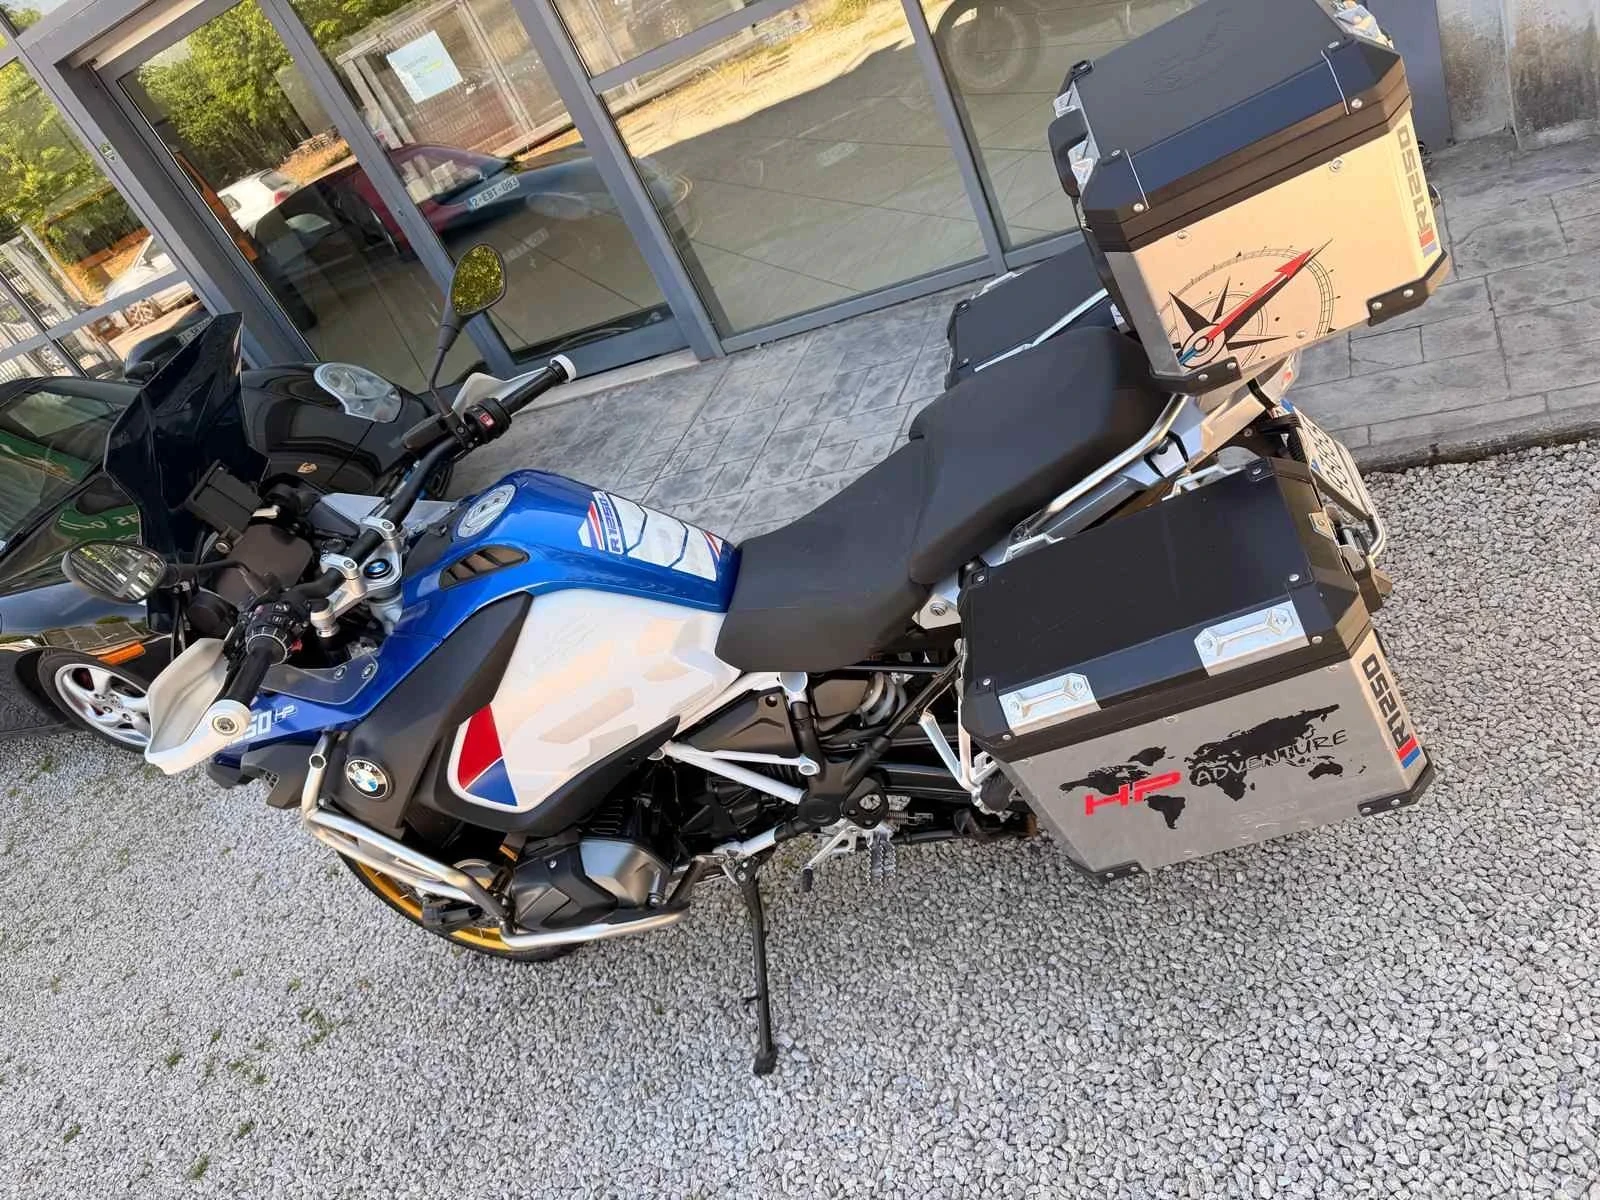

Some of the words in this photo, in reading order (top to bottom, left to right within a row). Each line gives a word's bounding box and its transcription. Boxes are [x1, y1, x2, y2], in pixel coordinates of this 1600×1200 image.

[1397, 125, 1433, 232] R1250
[274, 704, 295, 722] HP
[1362, 653, 1410, 749] R1250
[1085, 771, 1181, 815] HP
[1196, 728, 1349, 785] ADVENTURE
